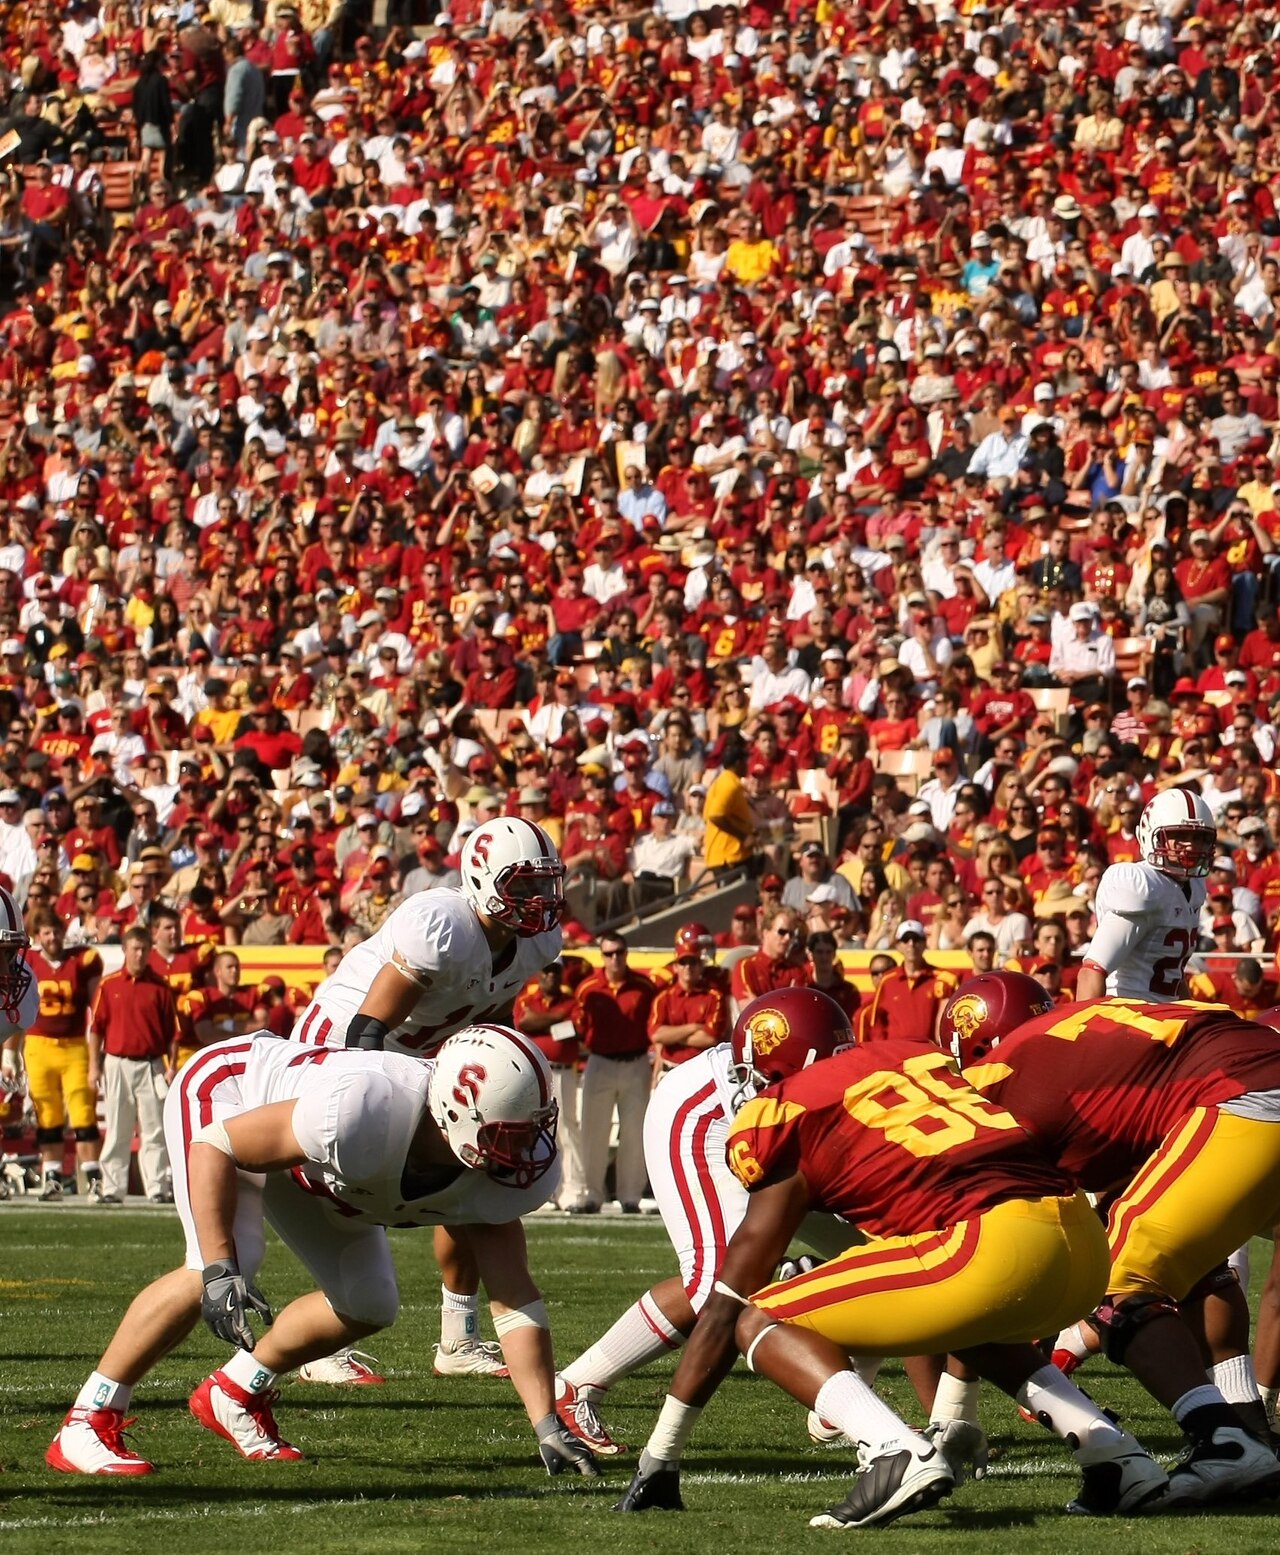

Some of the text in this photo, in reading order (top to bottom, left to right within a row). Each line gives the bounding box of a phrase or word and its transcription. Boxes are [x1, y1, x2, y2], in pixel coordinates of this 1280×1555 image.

[42, 739, 80, 756] USC
[453, 1062, 487, 1107] S
[843, 1052, 1020, 1158] 86
